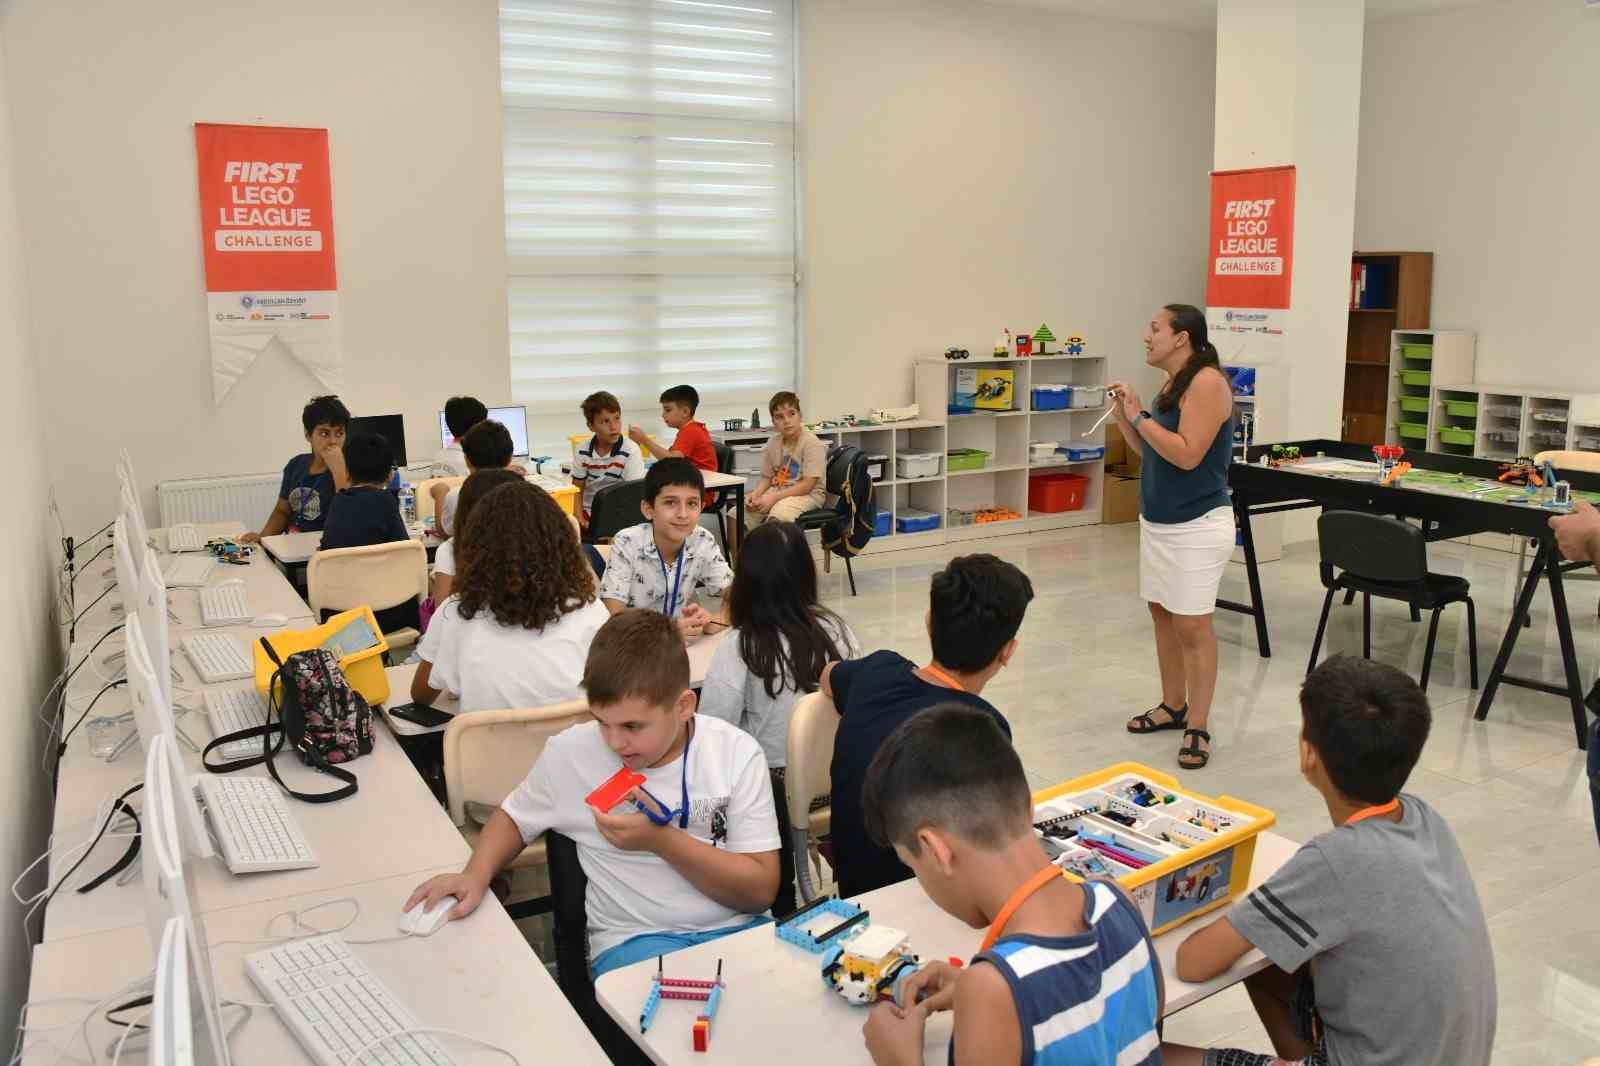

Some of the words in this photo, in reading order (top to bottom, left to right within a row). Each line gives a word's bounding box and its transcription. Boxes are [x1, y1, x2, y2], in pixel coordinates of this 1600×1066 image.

[224, 161, 303, 183] FIRST
[231, 186, 295, 205] LEGO
[219, 207, 312, 226] LEAGUE
[1224, 199, 1276, 219] FIRST
[1227, 220, 1268, 236] LEGO
[224, 235, 313, 247] CHALLENGE
[1219, 238, 1278, 254] LEAGUE
[1220, 261, 1277, 273] CHALLENGE
